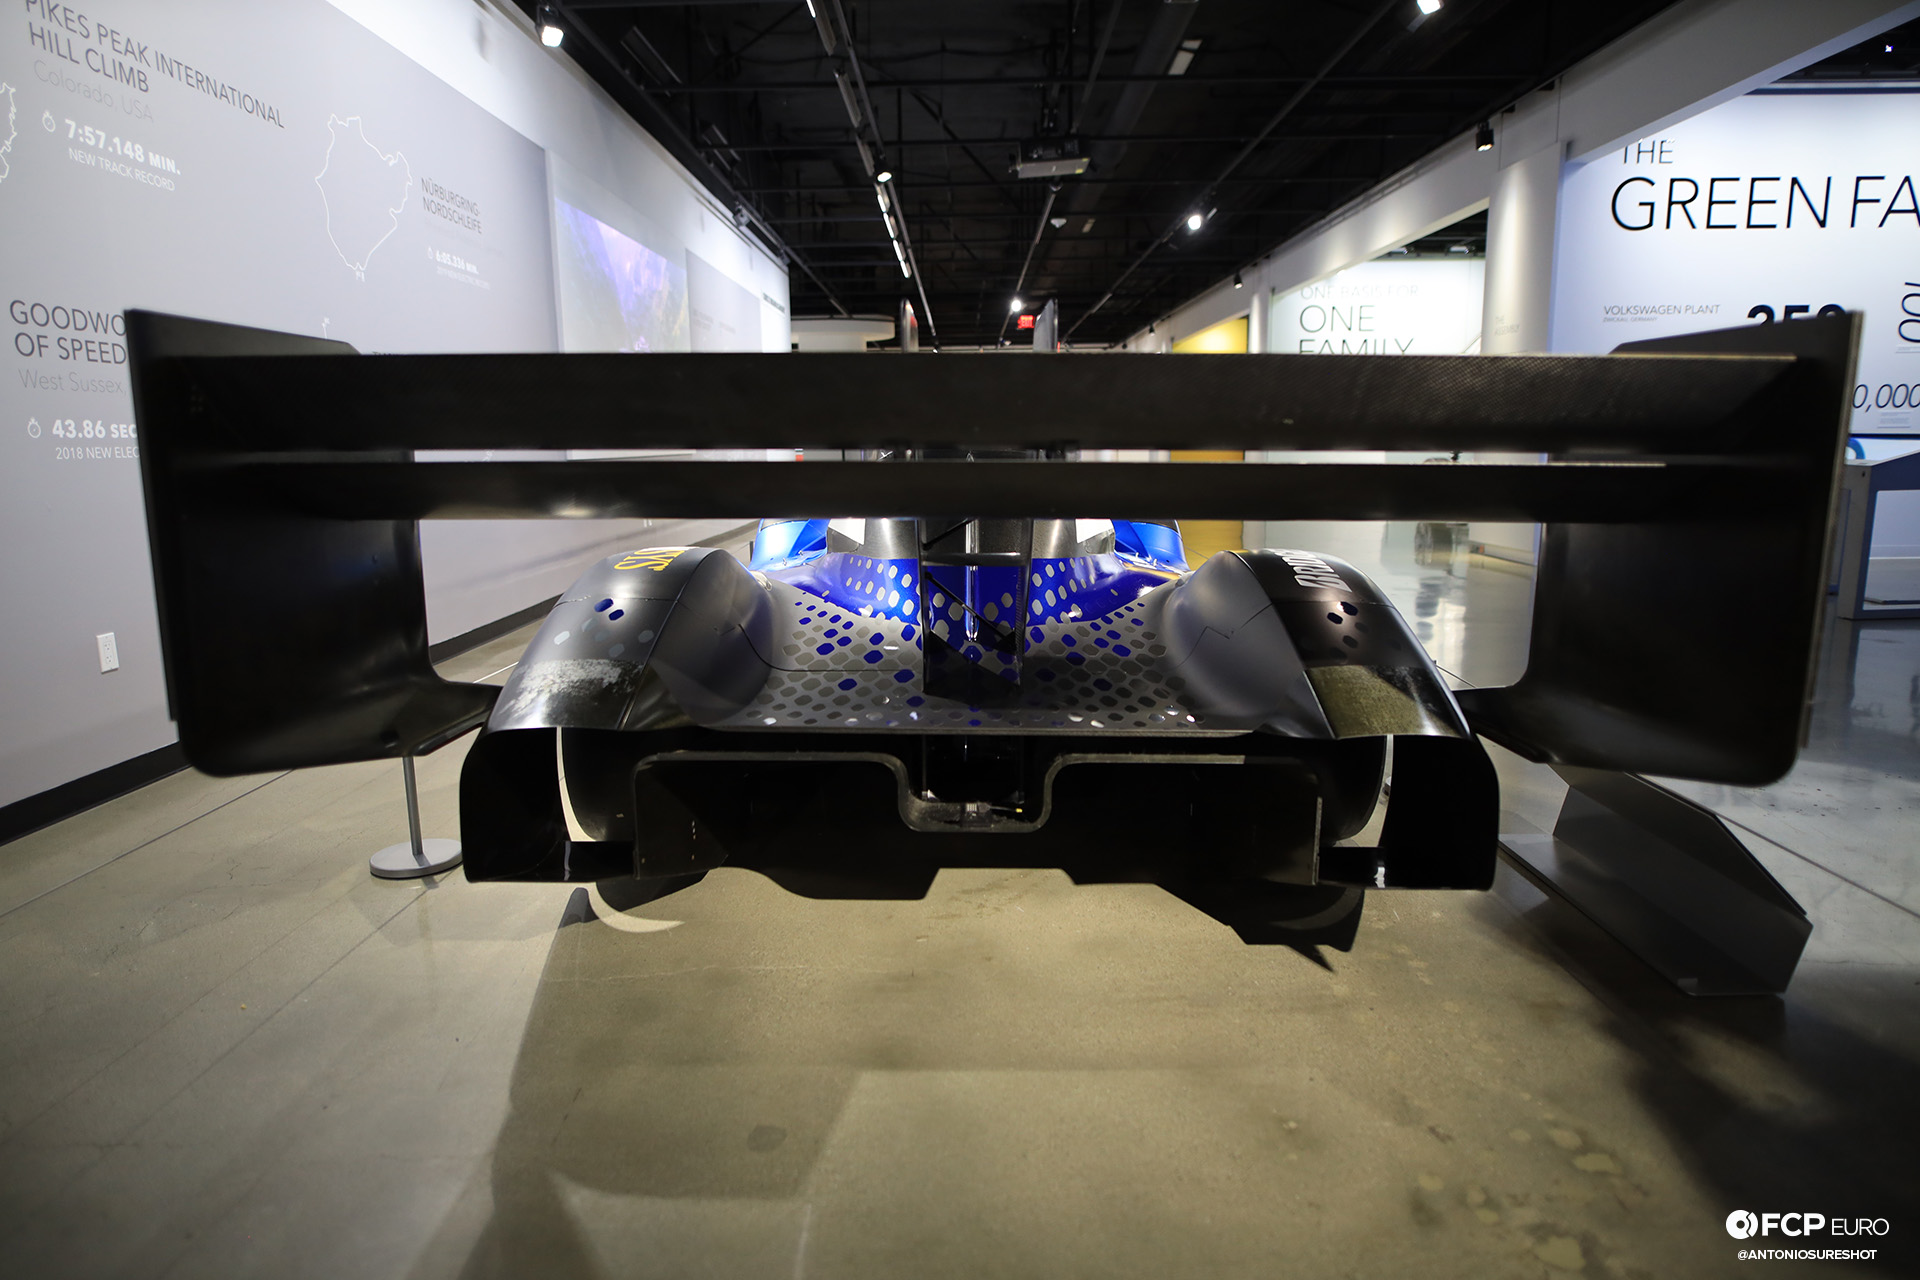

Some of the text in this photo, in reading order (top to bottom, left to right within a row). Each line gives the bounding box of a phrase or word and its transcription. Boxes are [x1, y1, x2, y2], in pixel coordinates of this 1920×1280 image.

[26, 0, 285, 128] PIKES PEAK INTERNATIONAL
[28, 21, 149, 92] HILL CLIMB
[122, 98, 154, 122] USA
[65, 119, 182, 175] 7:57.148 MIN.
[68, 148, 175, 191] NEW TRACK RECORD
[423, 197, 482, 234] NORDSCHLEIFE
[1611, 175, 1920, 231] GREEN FA
[1300, 285, 1334, 300] ONE
[1300, 305, 1375, 333] ONE
[1604, 304, 1721, 315] VOLKSWAGEN PLANT
[15, 332, 127, 364] OF SPEED
[18, 368, 127, 395] West Sussex,
[52, 418, 106, 439] 43.86
[56, 447, 84, 459] 2018
[86, 447, 112, 459] NEW
